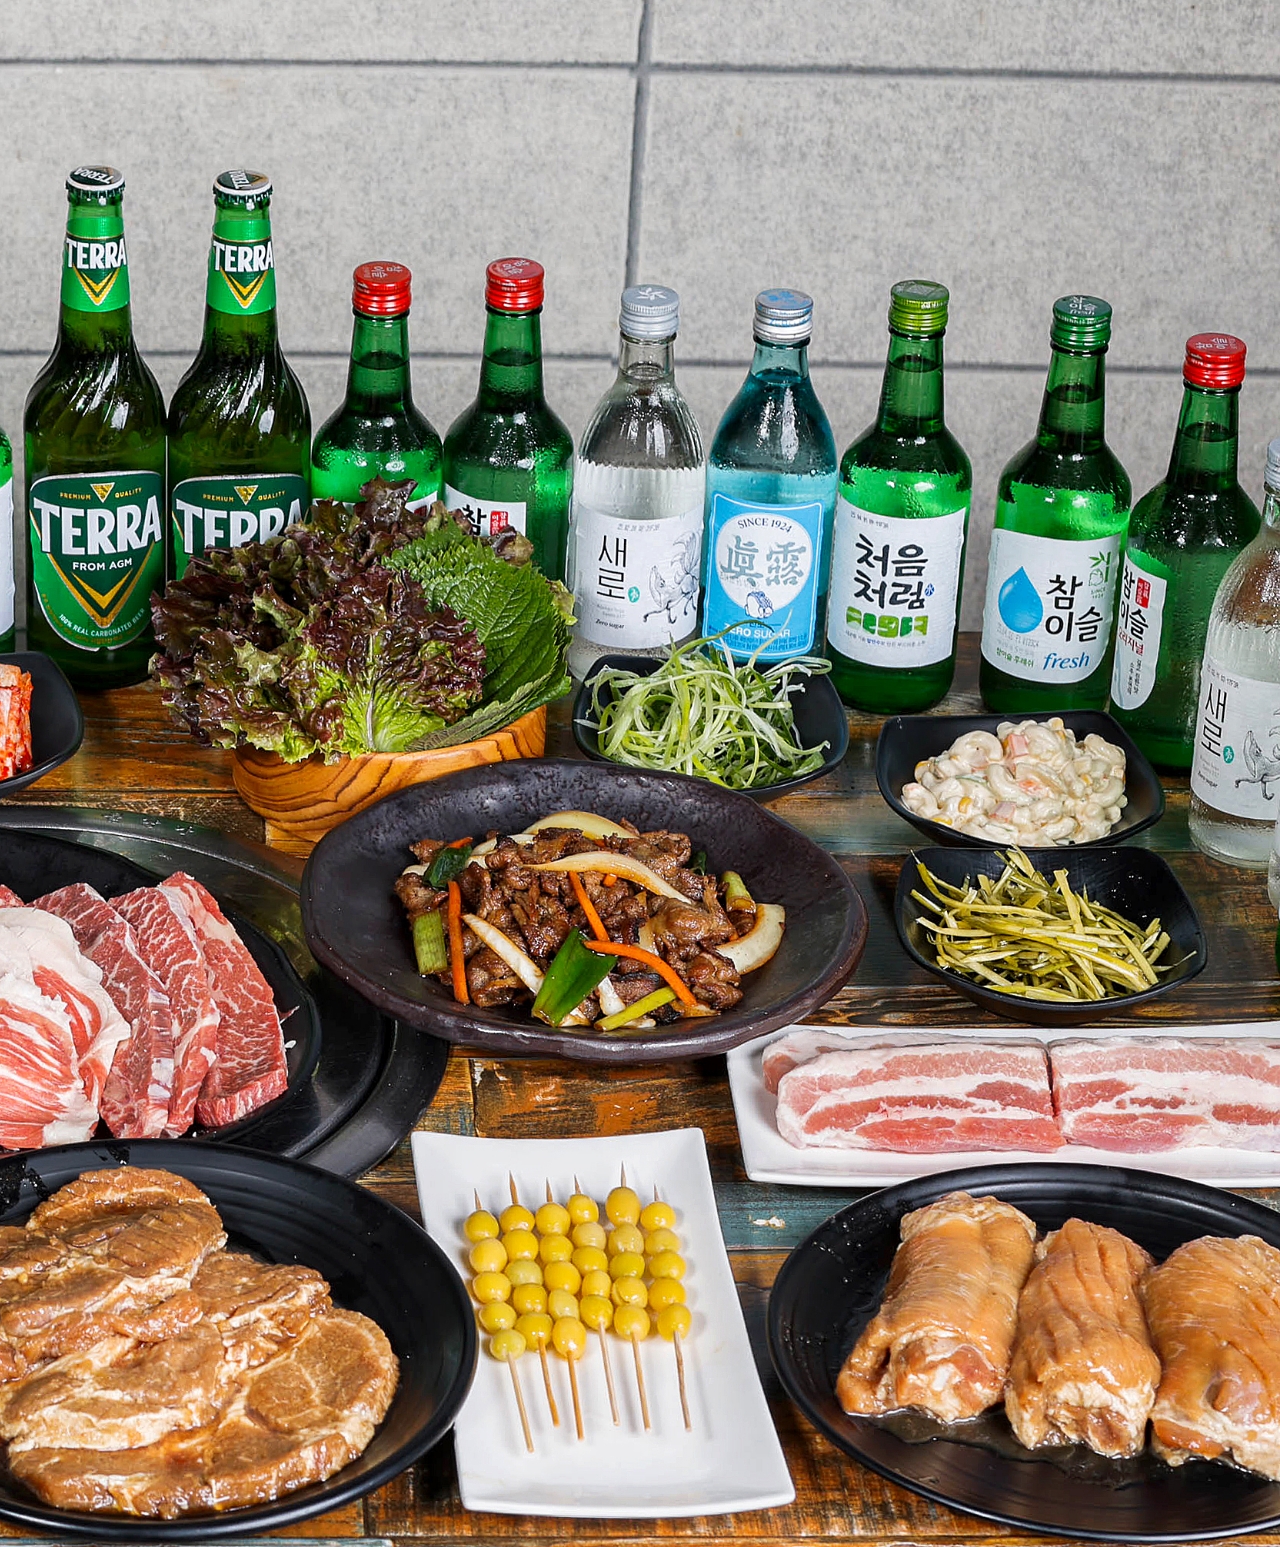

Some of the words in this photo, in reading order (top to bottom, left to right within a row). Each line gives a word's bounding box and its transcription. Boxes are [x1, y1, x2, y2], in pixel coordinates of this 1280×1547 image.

[74, 168, 114, 184] TERRA
[66, 237, 127, 269] TERRA
[213, 240, 274, 272] TERRA
[60, 491, 91, 500] PREMIUM
[115, 488, 142, 498] QUALITY
[202, 493, 234, 502] PREMIUM
[258, 490, 286, 501] QUALITY
[33, 494, 162, 555] TERRA
[462, 504, 487, 536] 참
[738, 517, 768, 529] SINCE
[771, 519, 792, 533] 1924
[73, 561, 105, 571] FROM
[109, 557, 133, 570] AGM
[597, 535, 627, 599] 새로
[855, 533, 928, 577] 처음
[853, 569, 925, 610] 처럼
[1046, 574, 1083, 610] 참
[73, 625, 89, 636] REAL
[91, 622, 132, 637] CARBONATED
[132, 608, 145, 624] BEER
[1045, 606, 1103, 642] 이슬
[1042, 651, 1090, 671] fresh
